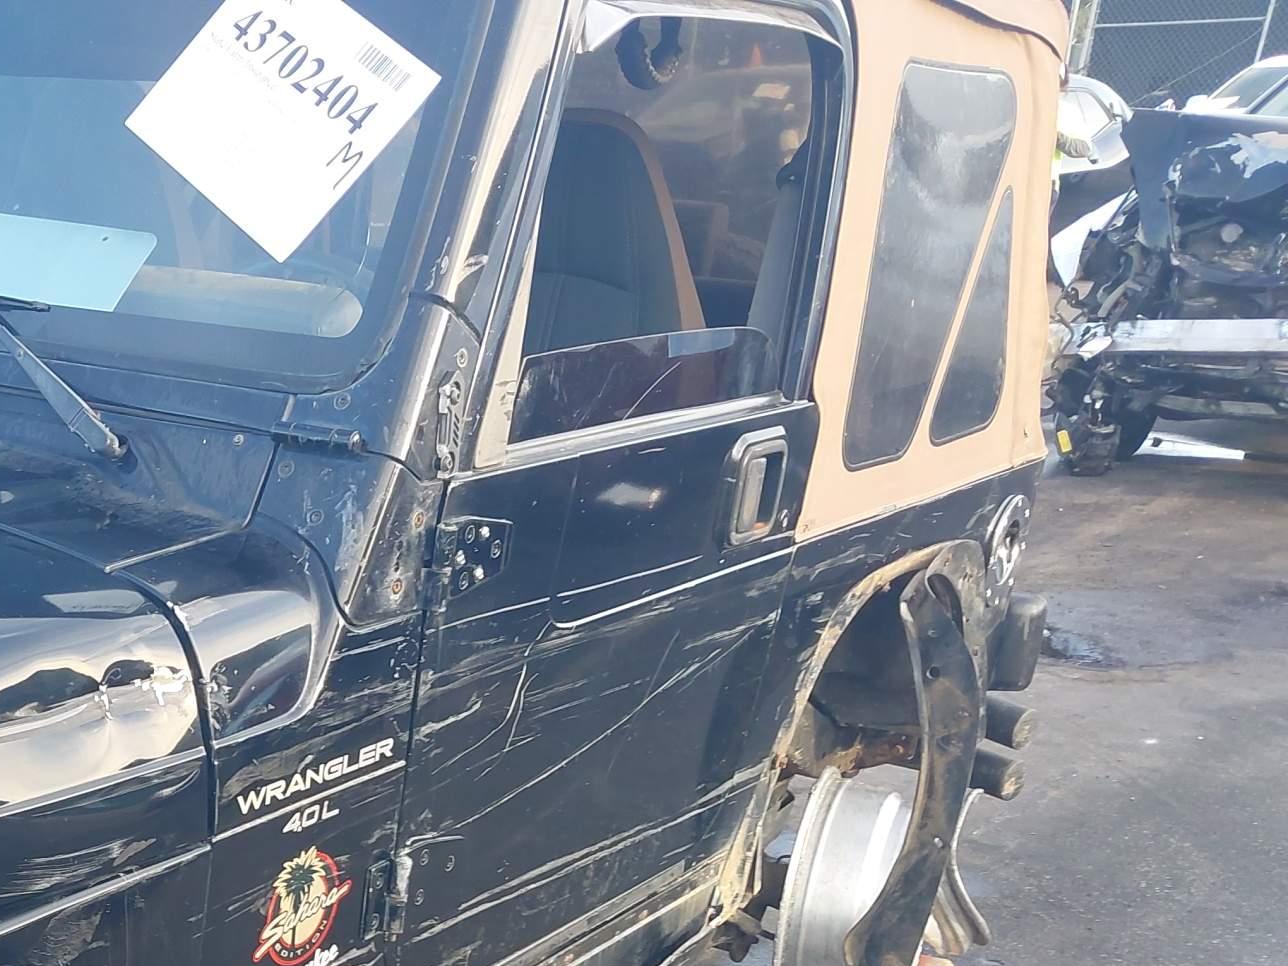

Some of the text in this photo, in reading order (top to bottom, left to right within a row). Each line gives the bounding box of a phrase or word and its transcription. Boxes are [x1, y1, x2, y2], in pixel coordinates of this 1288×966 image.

[231, 10, 379, 135] 43702404
[235, 737, 395, 816] WRANGLER
[253, 880, 352, 962] Sahara
[274, 919, 328, 959] EDITION
